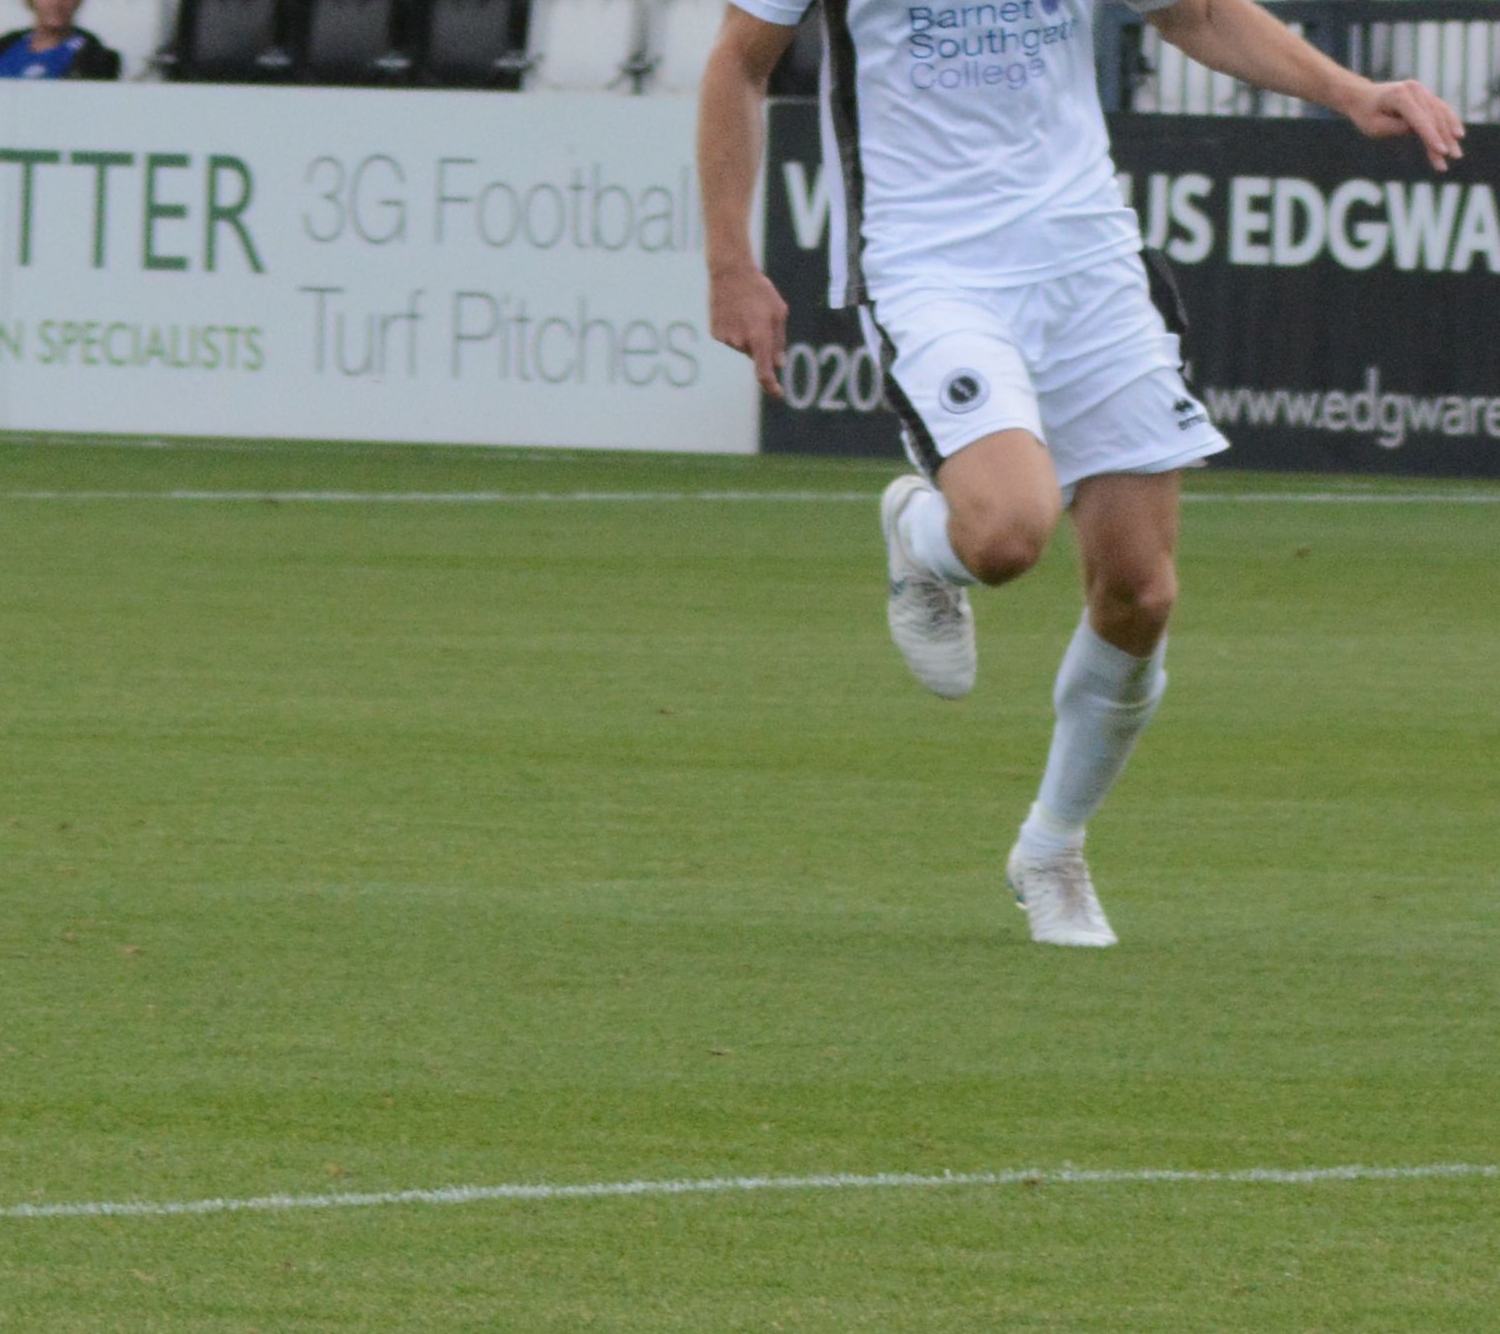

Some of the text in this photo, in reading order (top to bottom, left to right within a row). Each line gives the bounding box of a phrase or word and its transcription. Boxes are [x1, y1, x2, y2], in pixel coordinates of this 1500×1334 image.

[908, 19, 1077, 60] Southgat
[910, 57, 1047, 91] College
[301, 153, 408, 246] 3G
[36, 319, 266, 372] SPECIALISTS
[298, 284, 700, 389] Turf Pitches
[782, 341, 897, 413] 020
